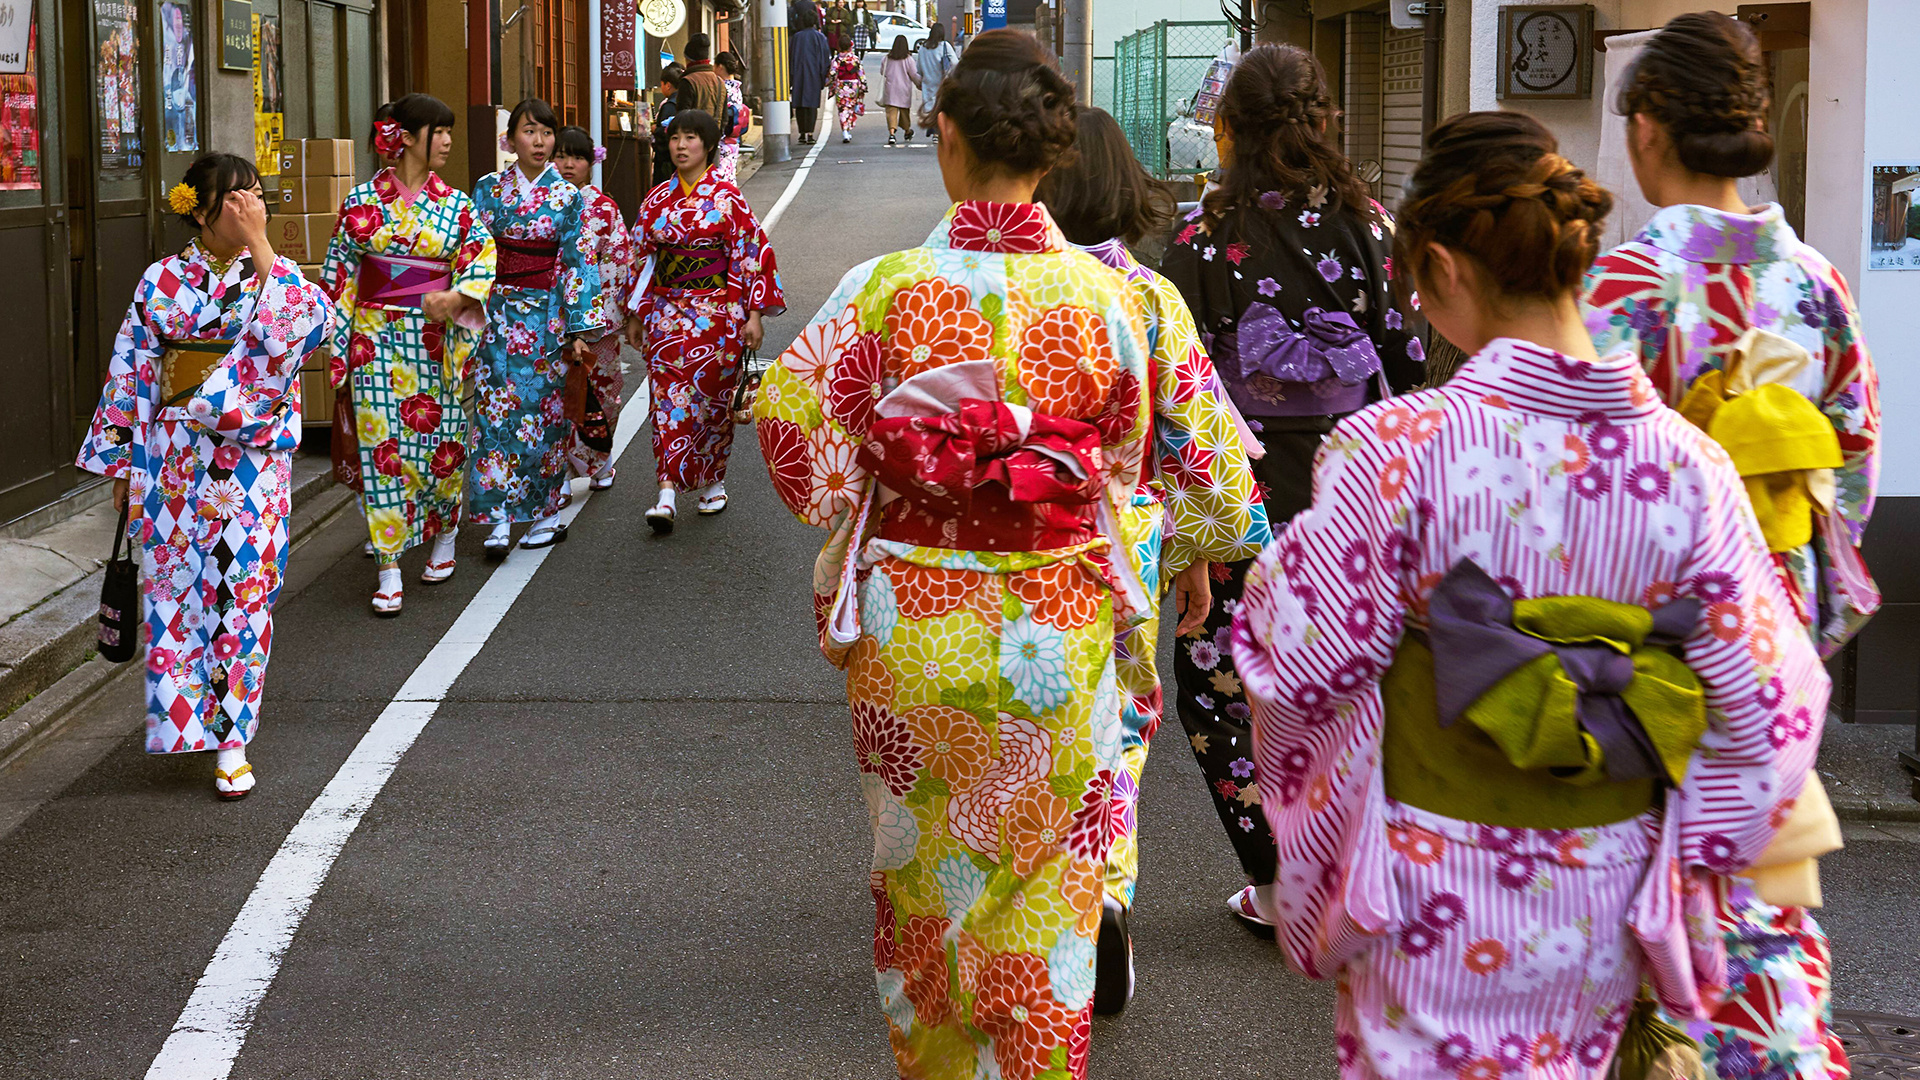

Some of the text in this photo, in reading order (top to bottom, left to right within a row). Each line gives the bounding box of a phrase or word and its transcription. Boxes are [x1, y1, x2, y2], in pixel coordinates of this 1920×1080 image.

[602, 3, 614, 77] みたらし団子
[1535, 20, 1549, 62] ごまや
